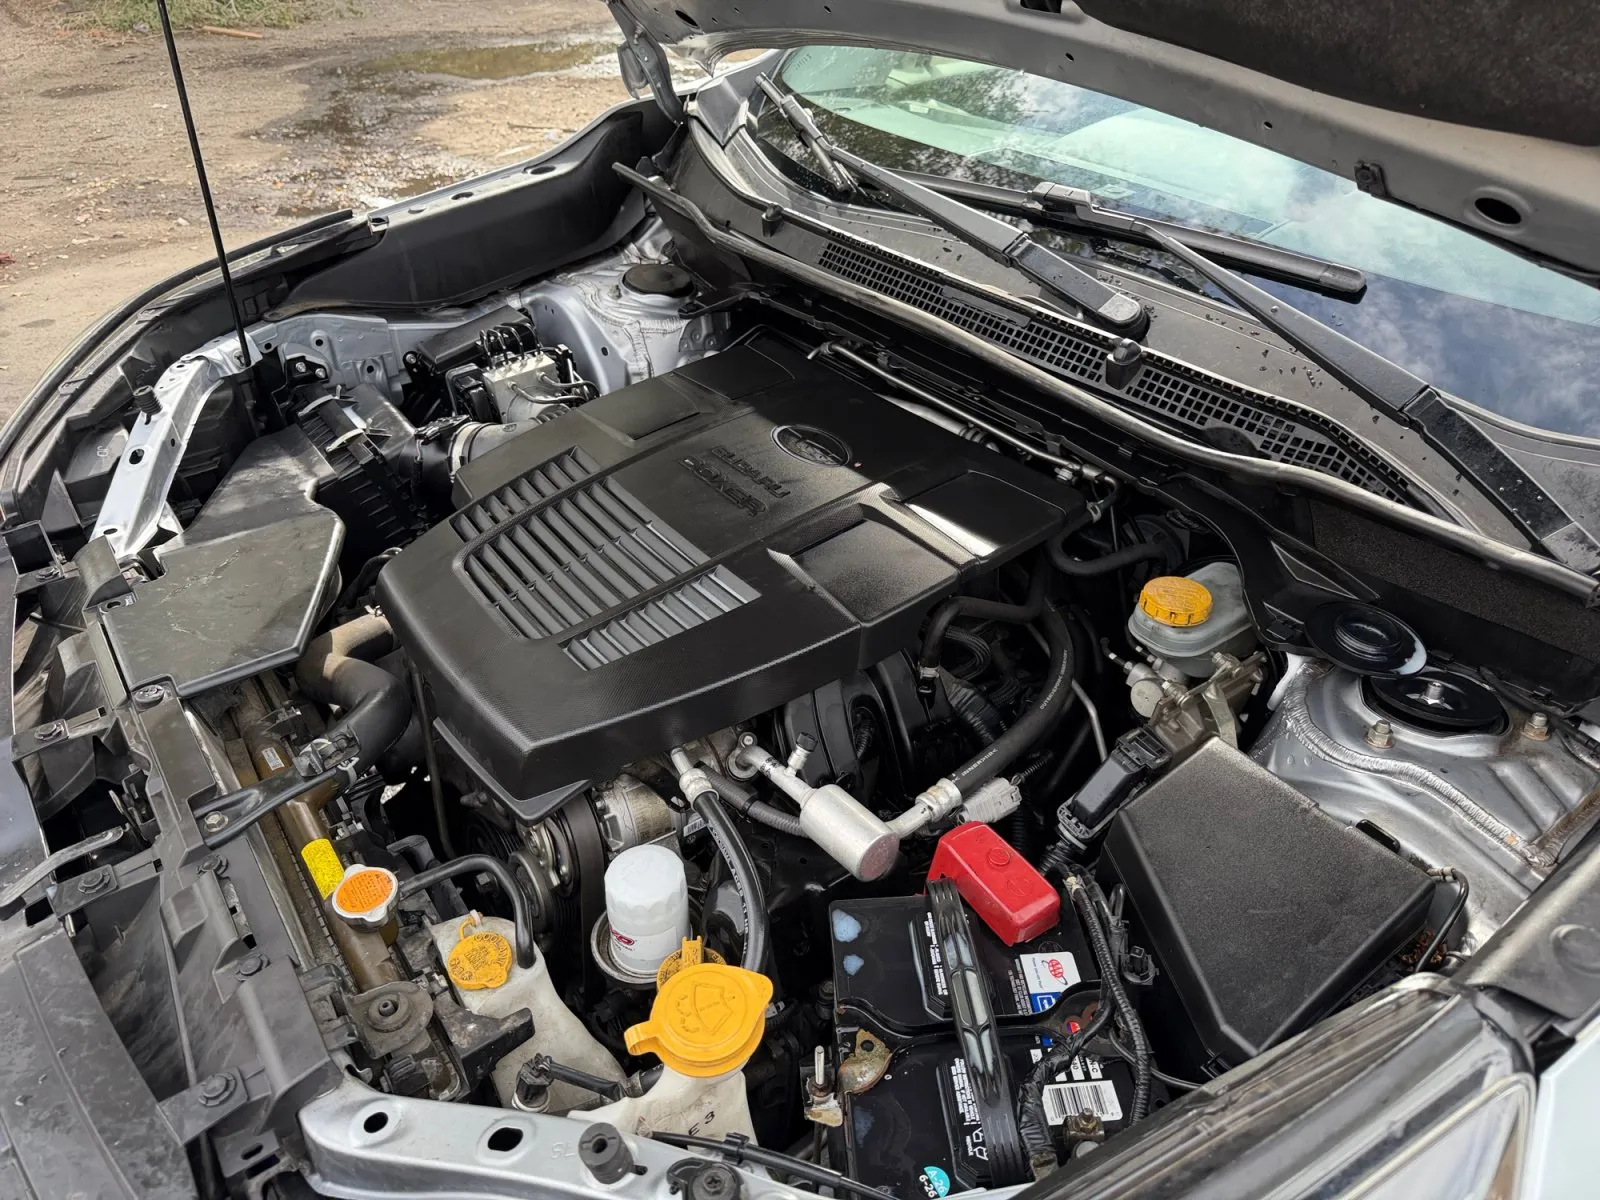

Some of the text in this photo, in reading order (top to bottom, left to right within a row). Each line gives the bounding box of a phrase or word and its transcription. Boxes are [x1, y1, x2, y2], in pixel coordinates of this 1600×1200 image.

[679, 456, 767, 517] BOXER
[711, 446, 791, 498] SUBARU
[474, 933, 507, 966] COOLANT
[918, 1172, 937, 1199] 6-26
[927, 1167, 947, 1194] A-26
